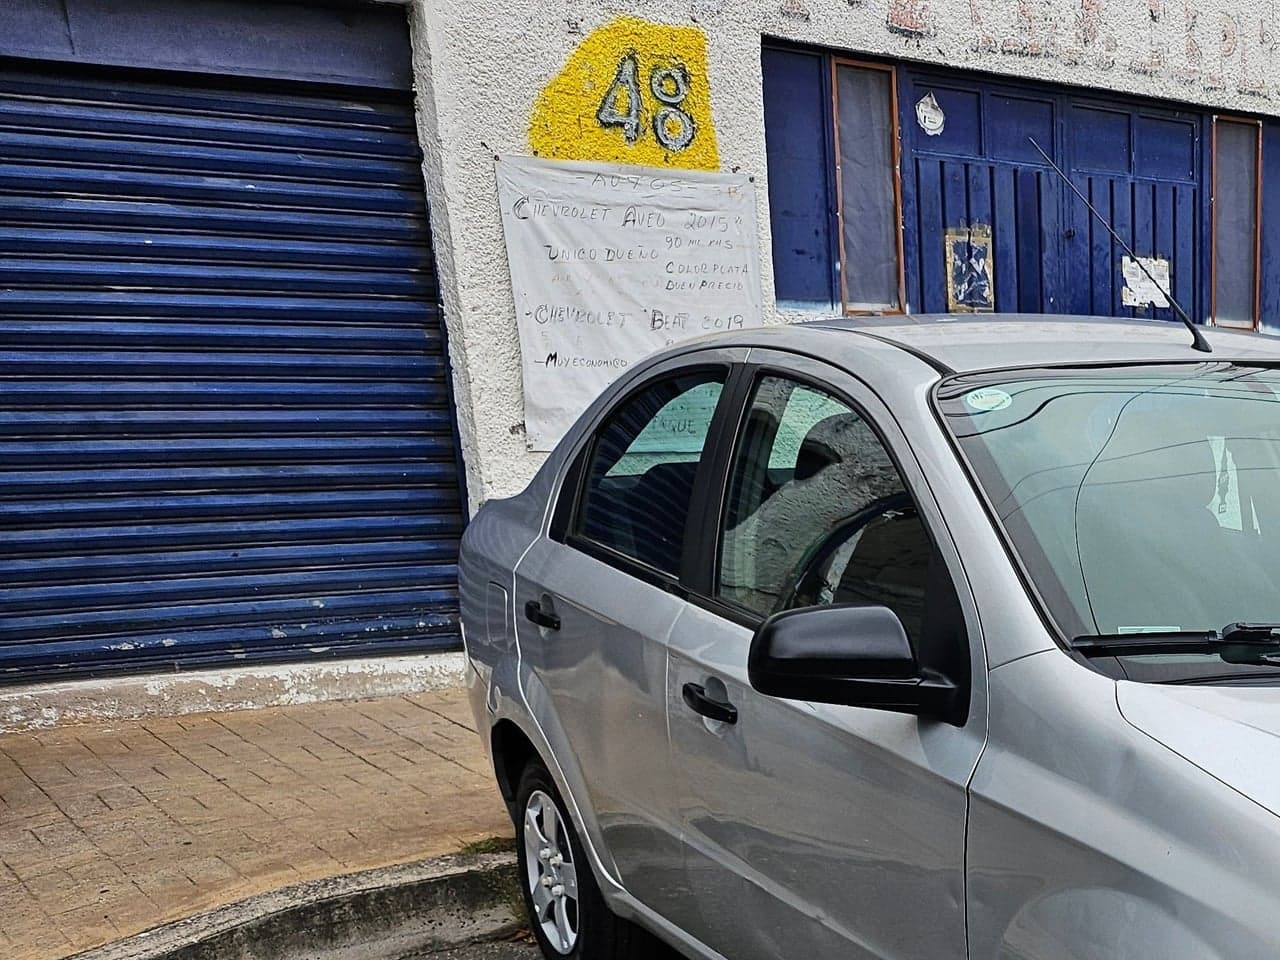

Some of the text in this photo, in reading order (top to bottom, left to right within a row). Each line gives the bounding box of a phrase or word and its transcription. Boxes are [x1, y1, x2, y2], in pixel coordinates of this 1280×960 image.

[596, 49, 696, 152] 48
[513, 196, 612, 222] CHEVROLET
[622, 205, 665, 228] AVEO
[665, 236, 682, 249] 90
[665, 261, 707, 274] COLOR
[535, 304, 632, 328] CHEVROLET
[651, 309, 689, 331] BEAT
